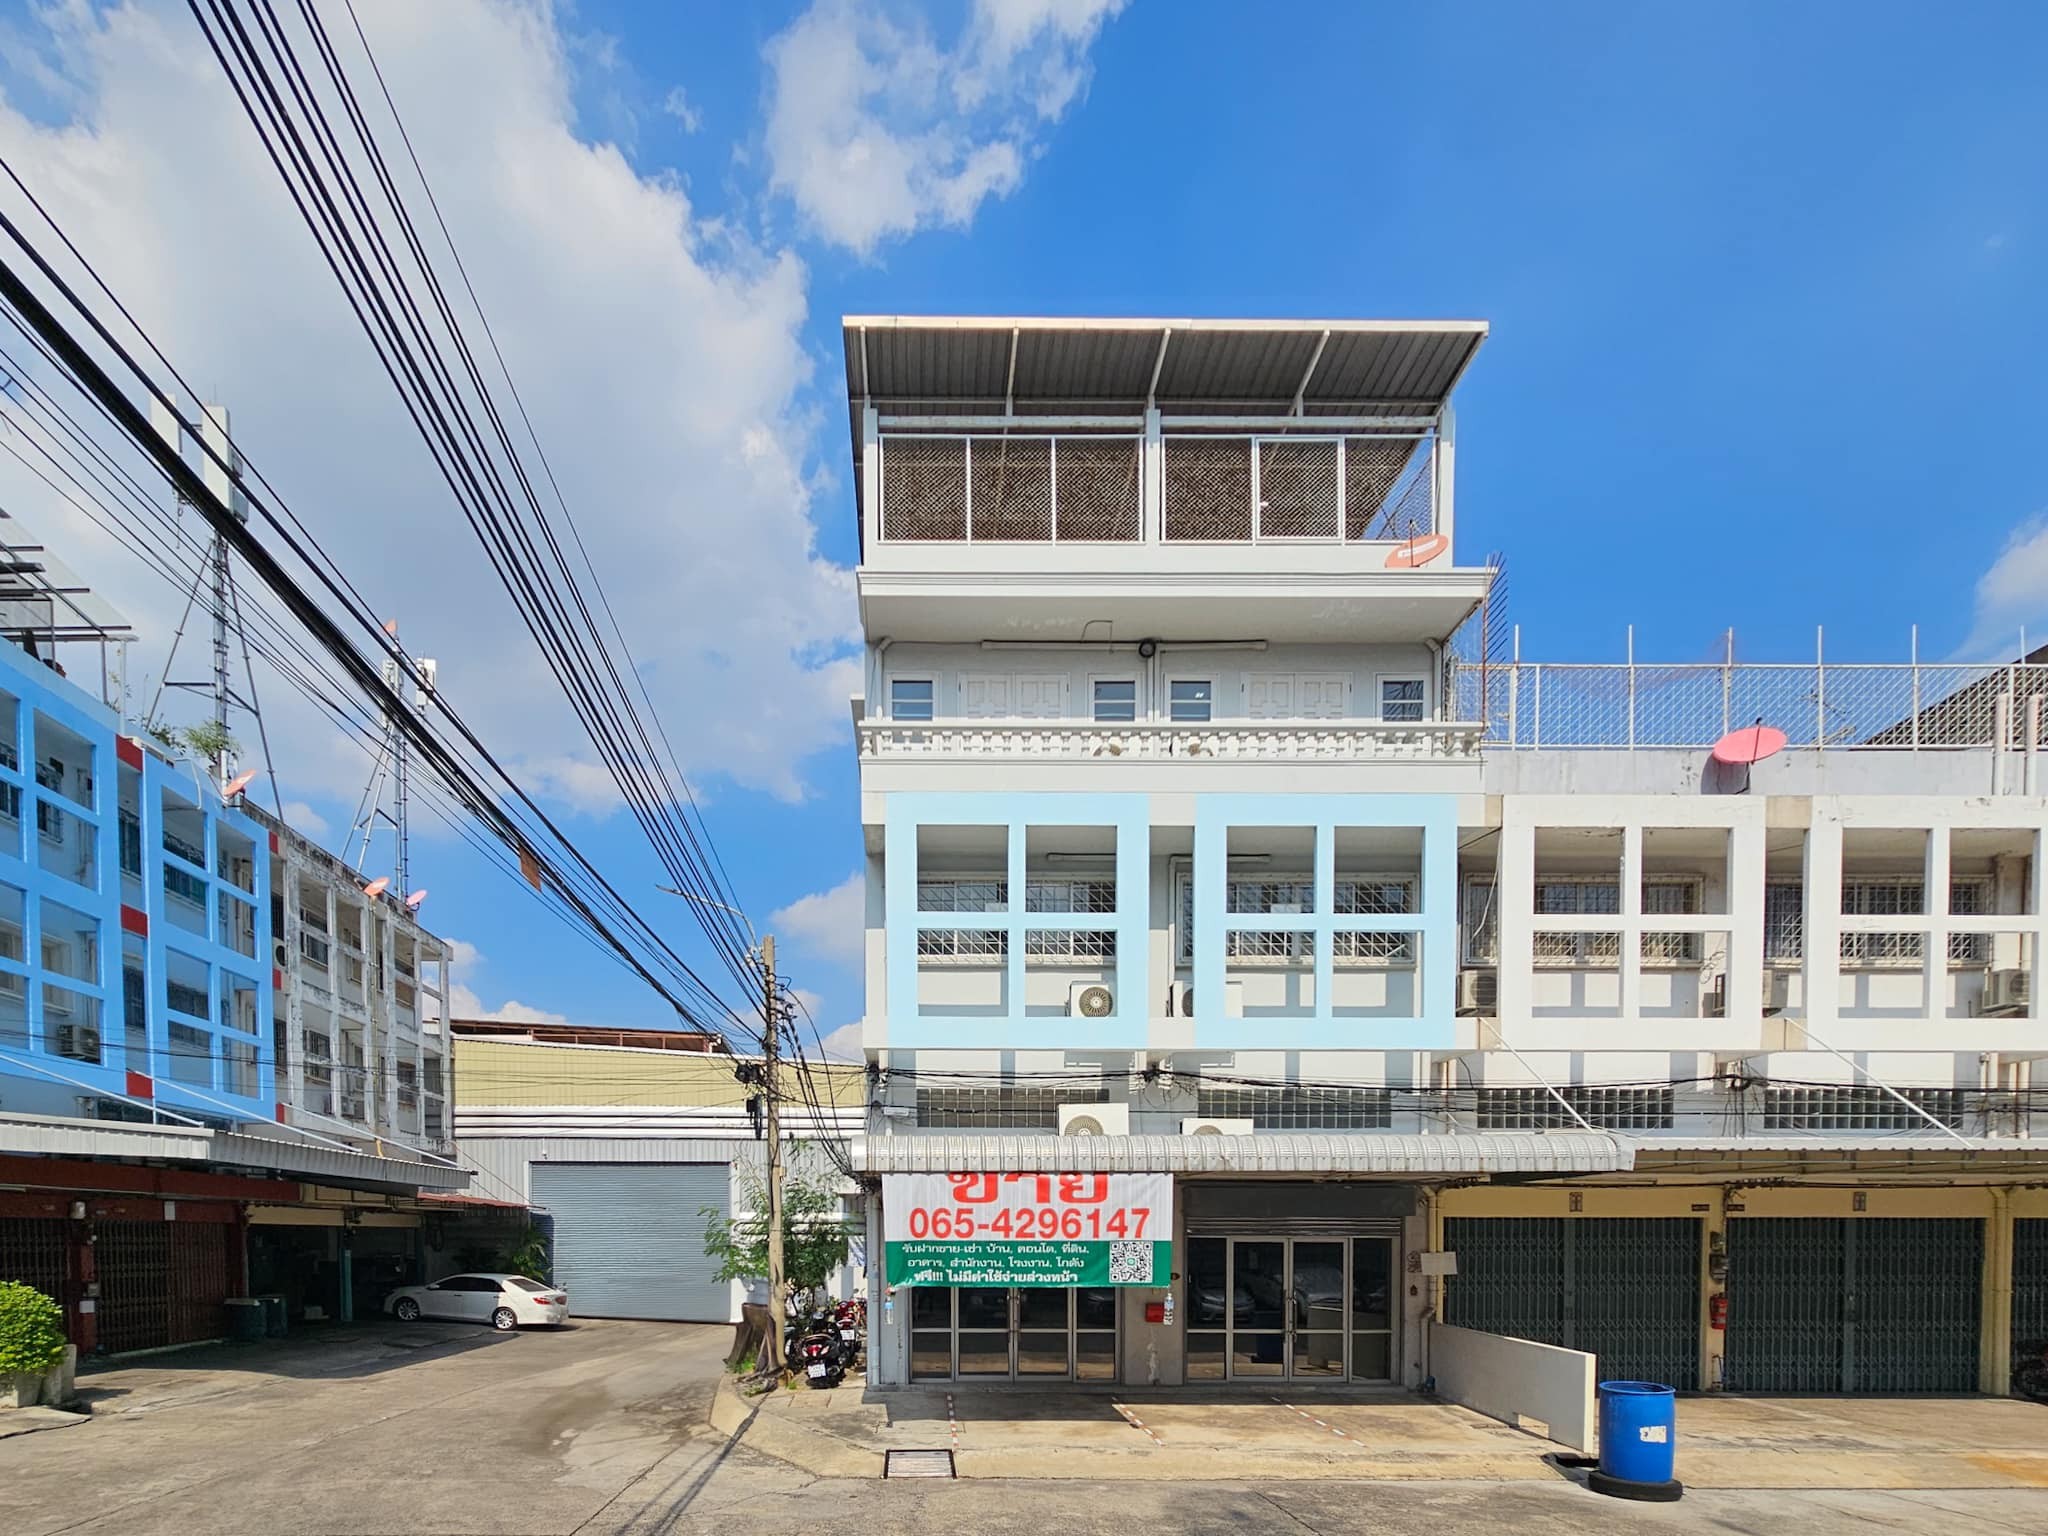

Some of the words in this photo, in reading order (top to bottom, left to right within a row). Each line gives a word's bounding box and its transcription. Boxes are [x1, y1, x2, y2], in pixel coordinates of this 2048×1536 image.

[948, 1173, 1109, 1204] ขาย
[909, 1207, 1150, 1239] 065-4296147
[1056, 1256, 1085, 1268] โกดัง
